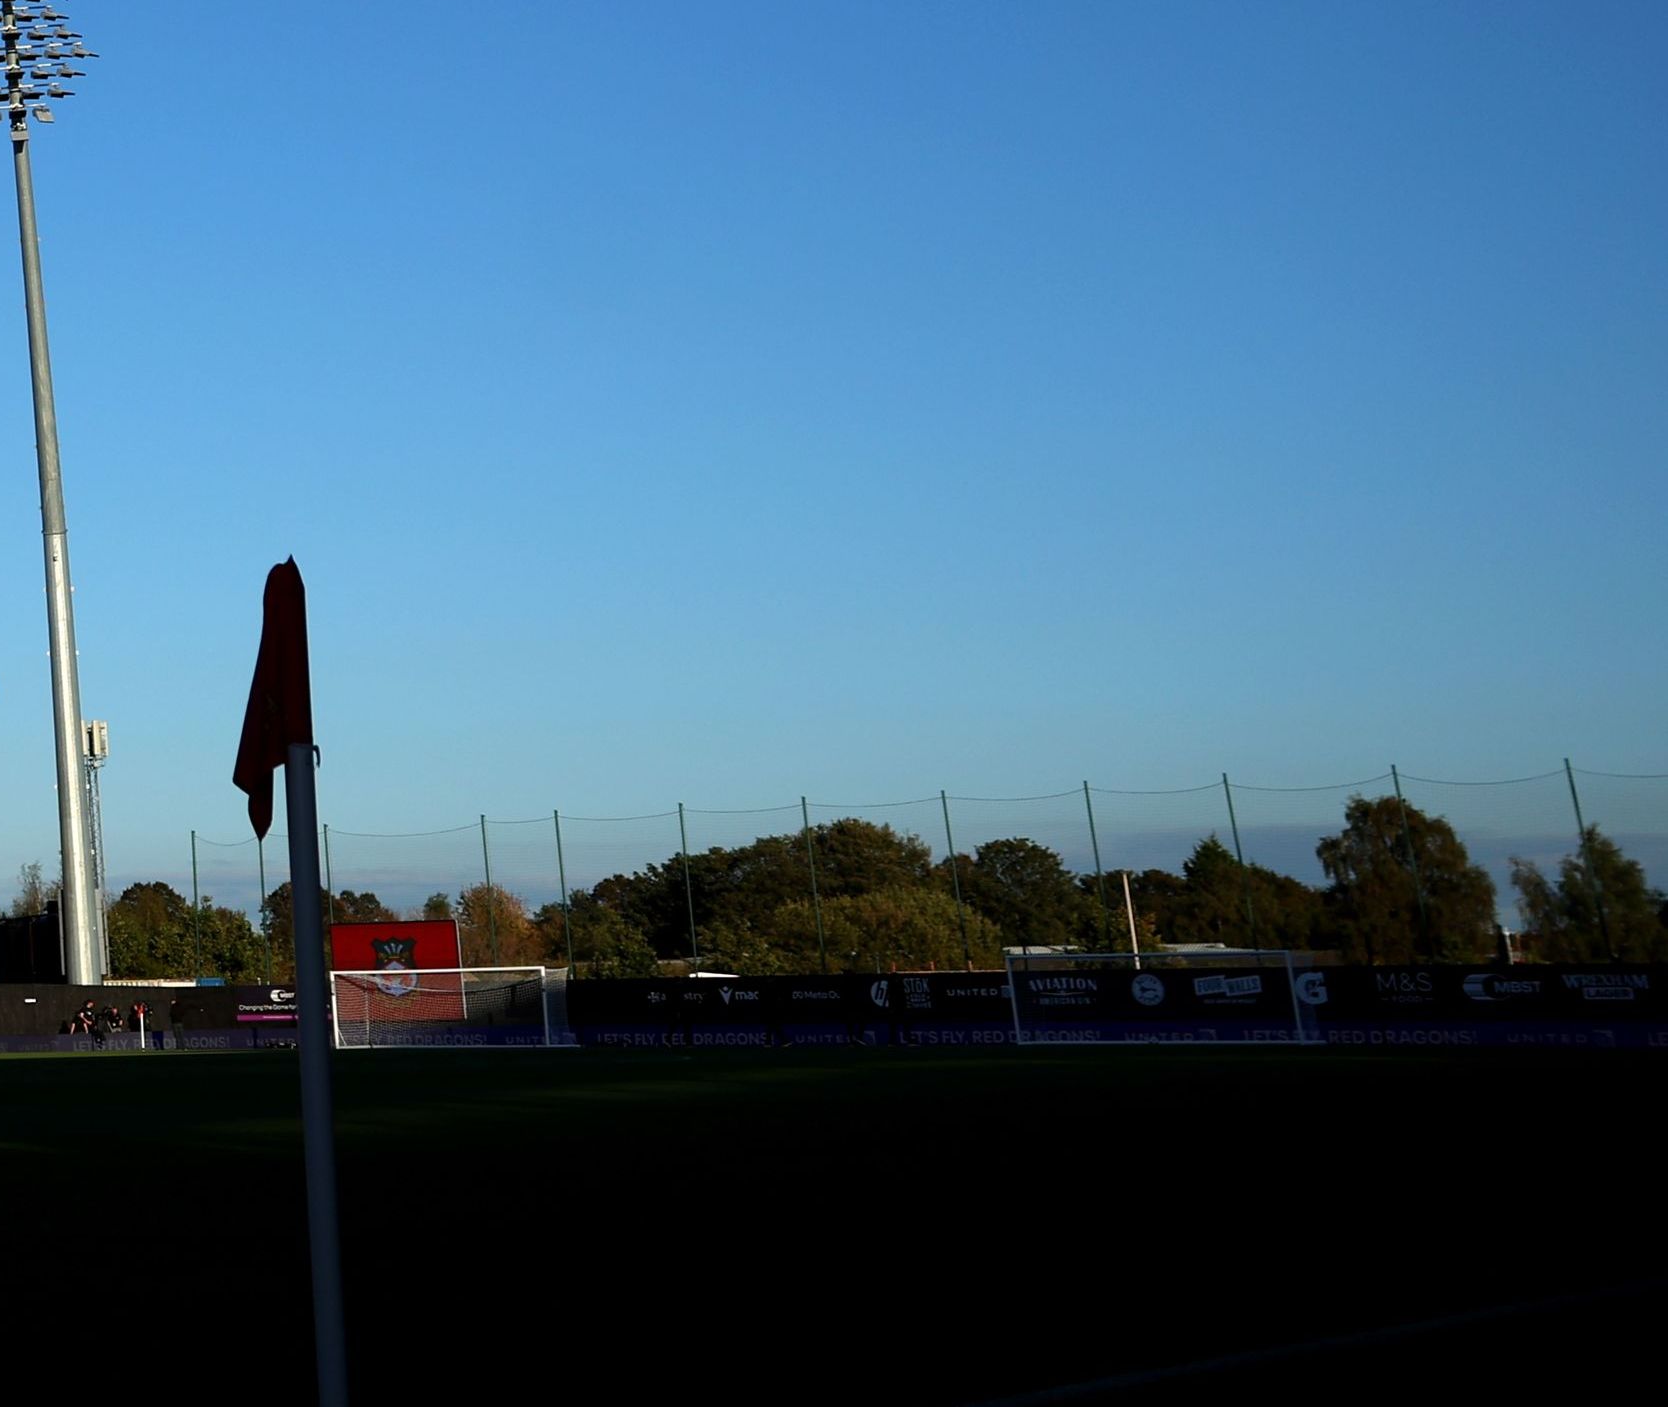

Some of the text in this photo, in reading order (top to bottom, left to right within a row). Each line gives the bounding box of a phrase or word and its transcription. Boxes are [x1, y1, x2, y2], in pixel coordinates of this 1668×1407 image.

[1028, 976, 1098, 992] AVIATION
[1375, 971, 1433, 993] M&S
[1493, 980, 1542, 993] MBST
[946, 988, 999, 997] UNITED
[972, 1031, 1005, 1044] RED
[1327, 1029, 1366, 1043] RED
[1370, 1030, 1479, 1045] DRAGONS!
[1507, 1032, 1589, 1044] UNITED
